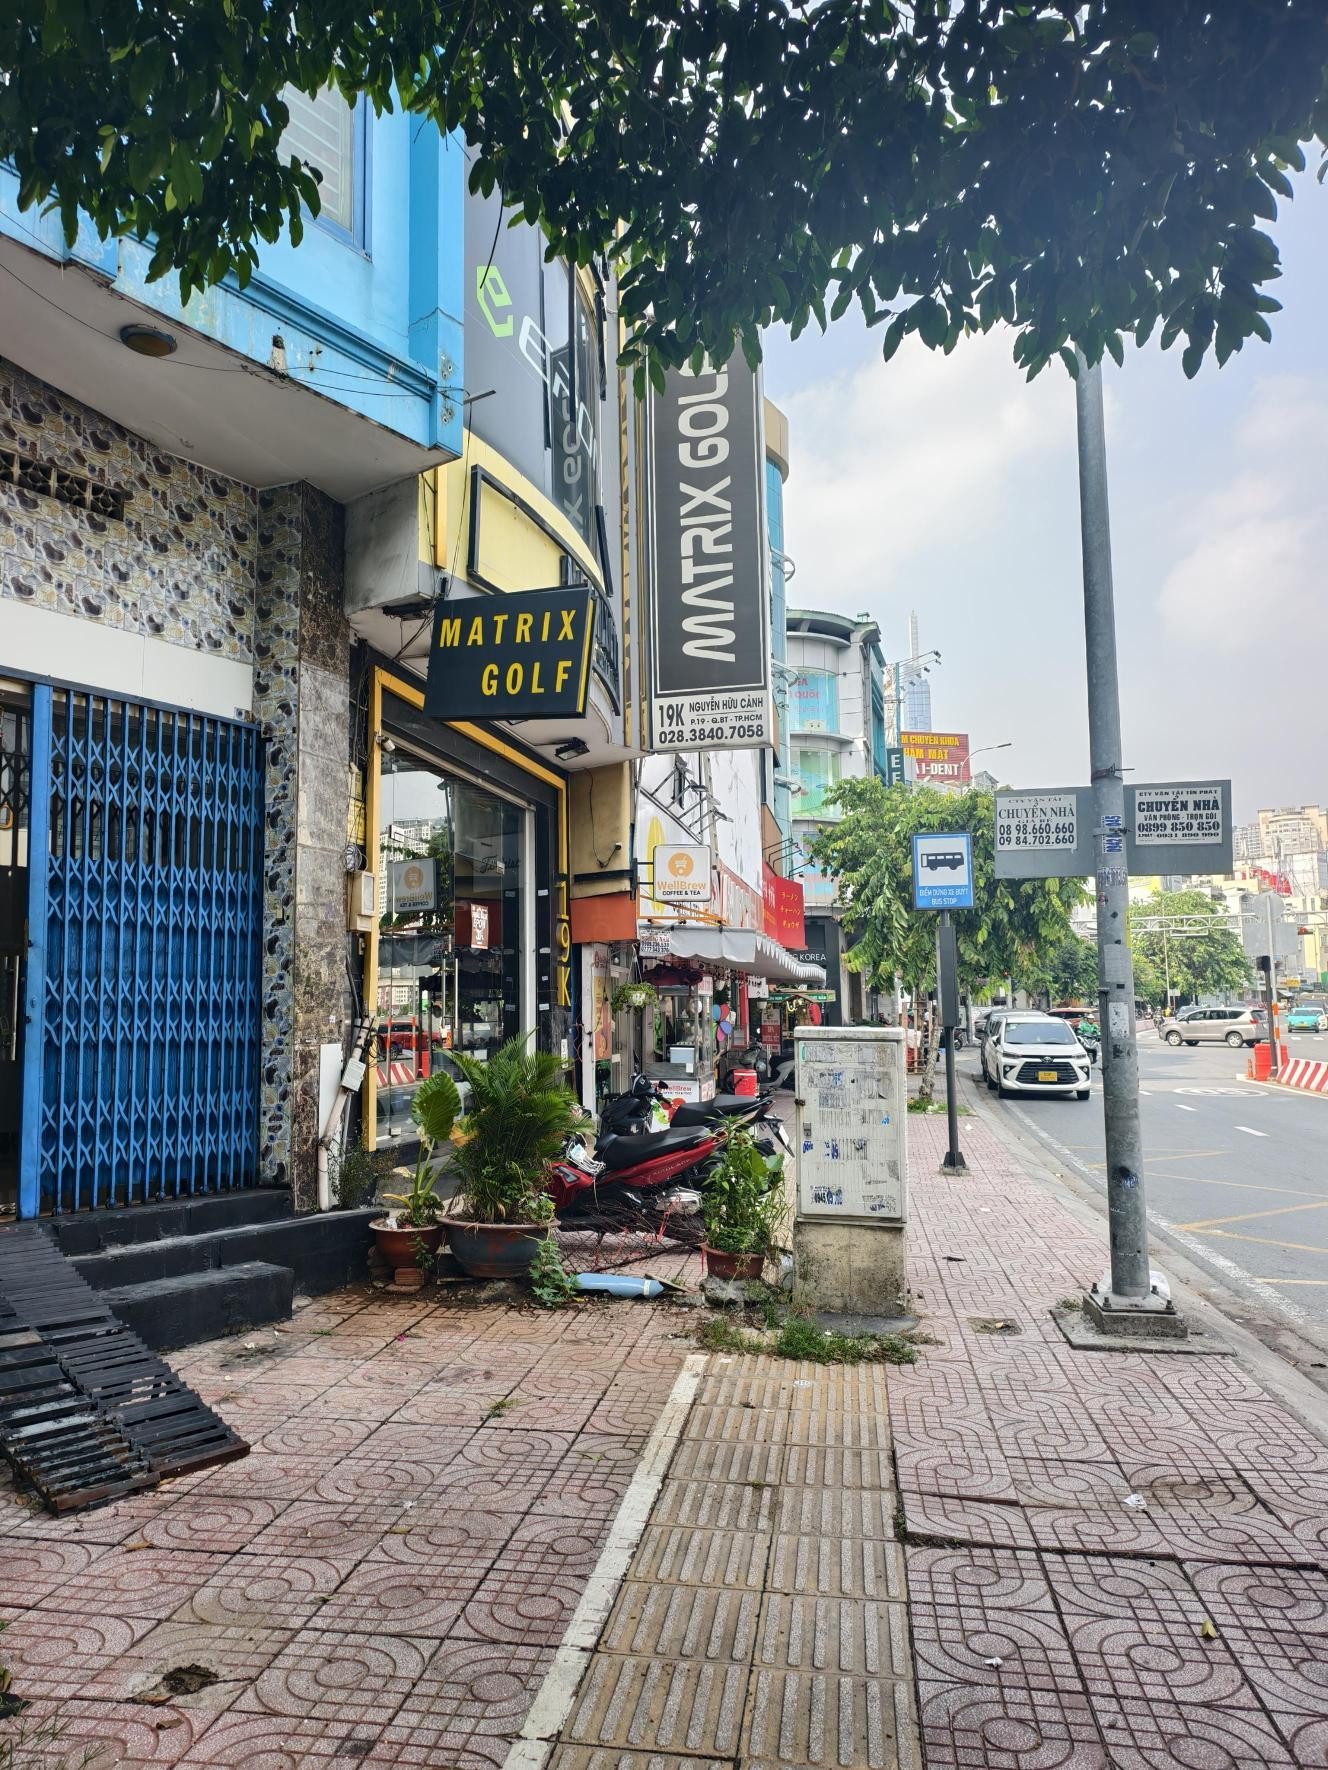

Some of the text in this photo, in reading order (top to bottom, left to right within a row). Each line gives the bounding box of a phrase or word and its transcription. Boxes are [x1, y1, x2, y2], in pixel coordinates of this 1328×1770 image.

[679, 476, 736, 662] MATRIX
[440, 609, 576, 648] MATRIX
[481, 660, 573, 696] GOLF
[689, 695, 763, 713] NGUYỄN HỮU CẢNH
[659, 703, 685, 728] 19K
[691, 718, 705, 726] P.19
[711, 716, 728, 724] Q.BT
[734, 714, 763, 723] TP.HCM
[659, 724, 764, 744] 028.3840.7058
[998, 802, 1075, 819] CHUYỂN NHÀ
[1137, 795, 1220, 812] CHUYỂN NHÀ
[999, 822, 1075, 836] 08 98.660.660
[1137, 820, 1220, 832] 0899 850 850
[999, 834, 1075, 846] 09 84.702.660
[656, 881, 706, 891] WellBrew
[948, 888, 955, 896] XE
[943, 897, 957, 905] STOP
[800, 953, 827, 961] KOREA
